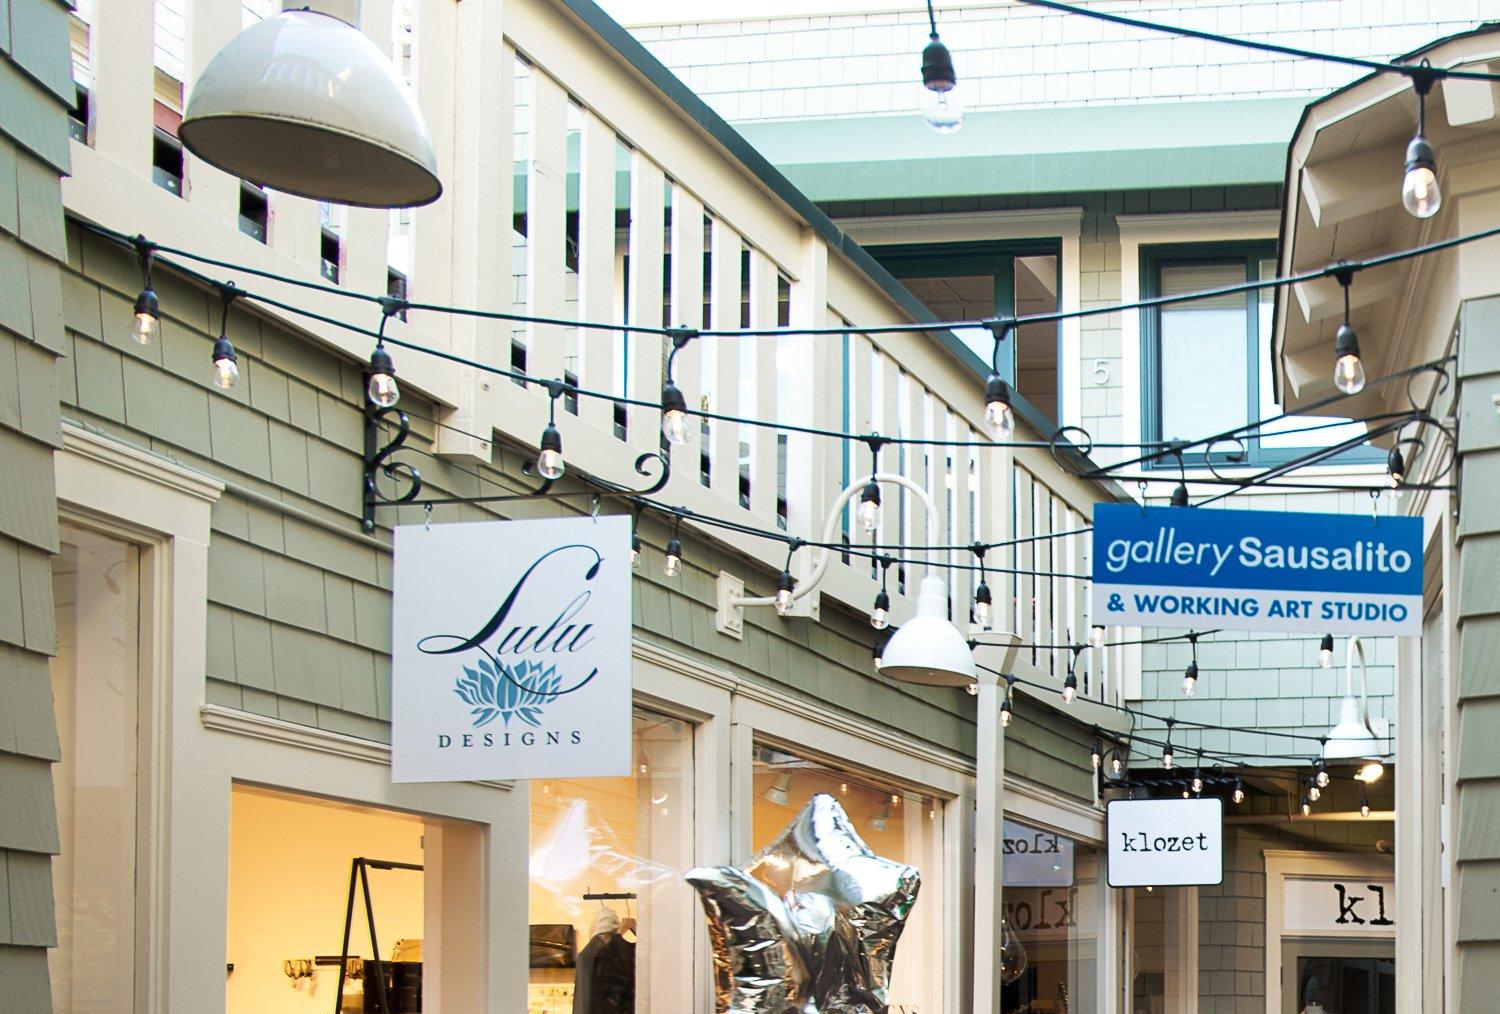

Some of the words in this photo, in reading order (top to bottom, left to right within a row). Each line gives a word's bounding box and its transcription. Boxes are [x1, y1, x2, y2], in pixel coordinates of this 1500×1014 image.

[1094, 359, 1109, 384] 5
[1106, 527, 1233, 576] gallery
[1239, 536, 1412, 574] Sausalito
[416, 544, 605, 696] Lulu
[1107, 593, 1125, 612] &
[1134, 594, 1259, 617] WORKING
[1267, 599, 1313, 619] ART
[1321, 601, 1408, 623] STUDIO
[439, 730, 583, 748] DESIGNS
[1121, 832, 1209, 853] klozet
